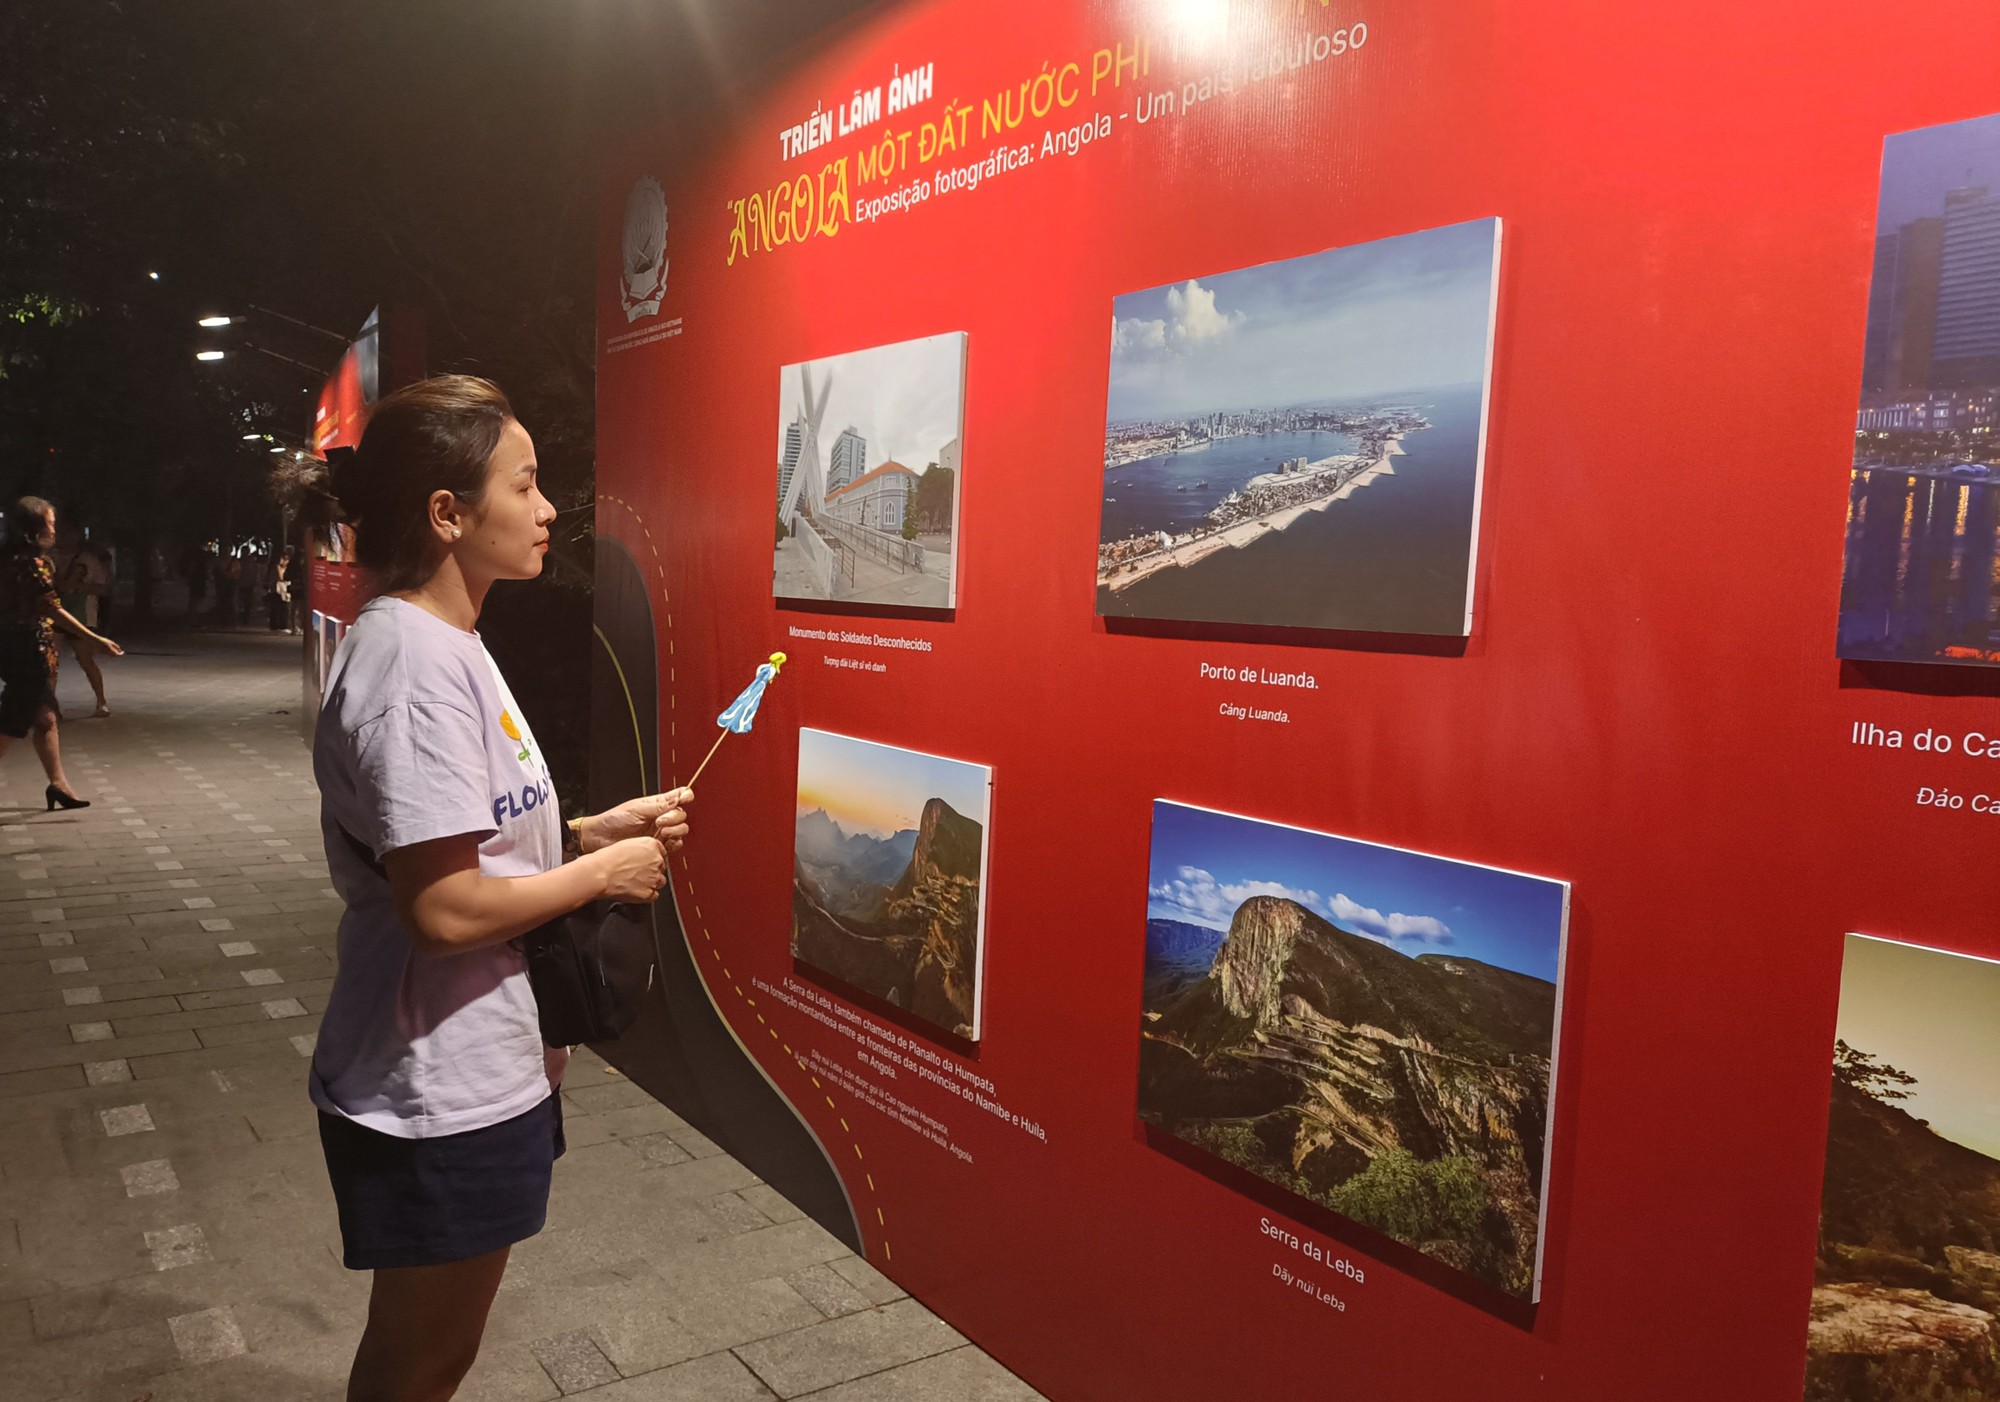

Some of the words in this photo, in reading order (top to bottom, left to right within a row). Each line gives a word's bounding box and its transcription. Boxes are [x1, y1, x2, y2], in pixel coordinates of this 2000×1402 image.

[780, 100, 833, 161] TRIỂN
[838, 90, 882, 137] LÃM
[887, 63, 934, 116] ẢNH
[857, 129, 912, 186] MỘT
[917, 98, 974, 164] ĐẤT
[982, 60, 1080, 139] NƯỚC
[855, 178, 930, 223] Exposição
[935, 143, 1035, 196] fotográfica:
[1040, 112, 1112, 159] Angola
[1136, 91, 1175, 124] Um
[789, 626, 826, 640] Monumento
[827, 630, 840, 642] dos
[840, 631, 873, 646] Soldados
[873, 634, 932, 652] Desconhecidos
[872, 662, 887, 673] danh
[1200, 662, 1236, 681] Porto
[1239, 666, 1257, 683] de
[1261, 668, 1319, 689] Luanda.
[1248, 706, 1290, 723] Luanda.
[1852, 721, 1903, 748] Ilha
[1913, 728, 1952, 753] do
[1963, 732, 2000, 759] Ca
[1916, 787, 1963, 809] Đảo
[1971, 794, 2000, 815] Ca
[757, 980, 769, 993] uma
[770, 984, 797, 1008] formação
[798, 1002, 837, 1029] montanhosa
[838, 1023, 856, 1039] entre
[857, 1033, 865, 1045] as
[866, 1035, 902, 1064] fronteiras
[903, 1056, 917, 1072] das
[919, 1065, 961, 1095] províncias
[962, 1087, 974, 1102] do
[976, 1092, 1010, 1121] Namibe
[1012, 1114, 1018, 1126] e
[783, 977, 788, 988] A
[789, 979, 805, 996] Serra
[806, 989, 814, 1001] da
[815, 992, 833, 1013] Leba,
[834, 1003, 862, 1025] também
[863, 1020, 896, 1044] chamada
[897, 1035, 907, 1049] de
[909, 1040, 941, 1066] Planalto
[942, 1058, 953, 1073] da
[955, 1063, 997, 1097] Humpata,
[857, 1050, 868, 1063] em
[869, 1055, 897, 1079] Angola.
[885, 1092, 896, 1105] Cao
[920, 1111, 949, 1137] Humpata,
[899, 1113, 922, 1133] Namibe
[949, 1142, 974, 1164] Angola.
[1260, 1217, 1299, 1250] Serra
[1303, 1241, 1321, 1262] da
[1326, 1250, 1365, 1284] Leba
[1272, 1263, 1294, 1286] Dãy
[1316, 1287, 1346, 1312] Leba
